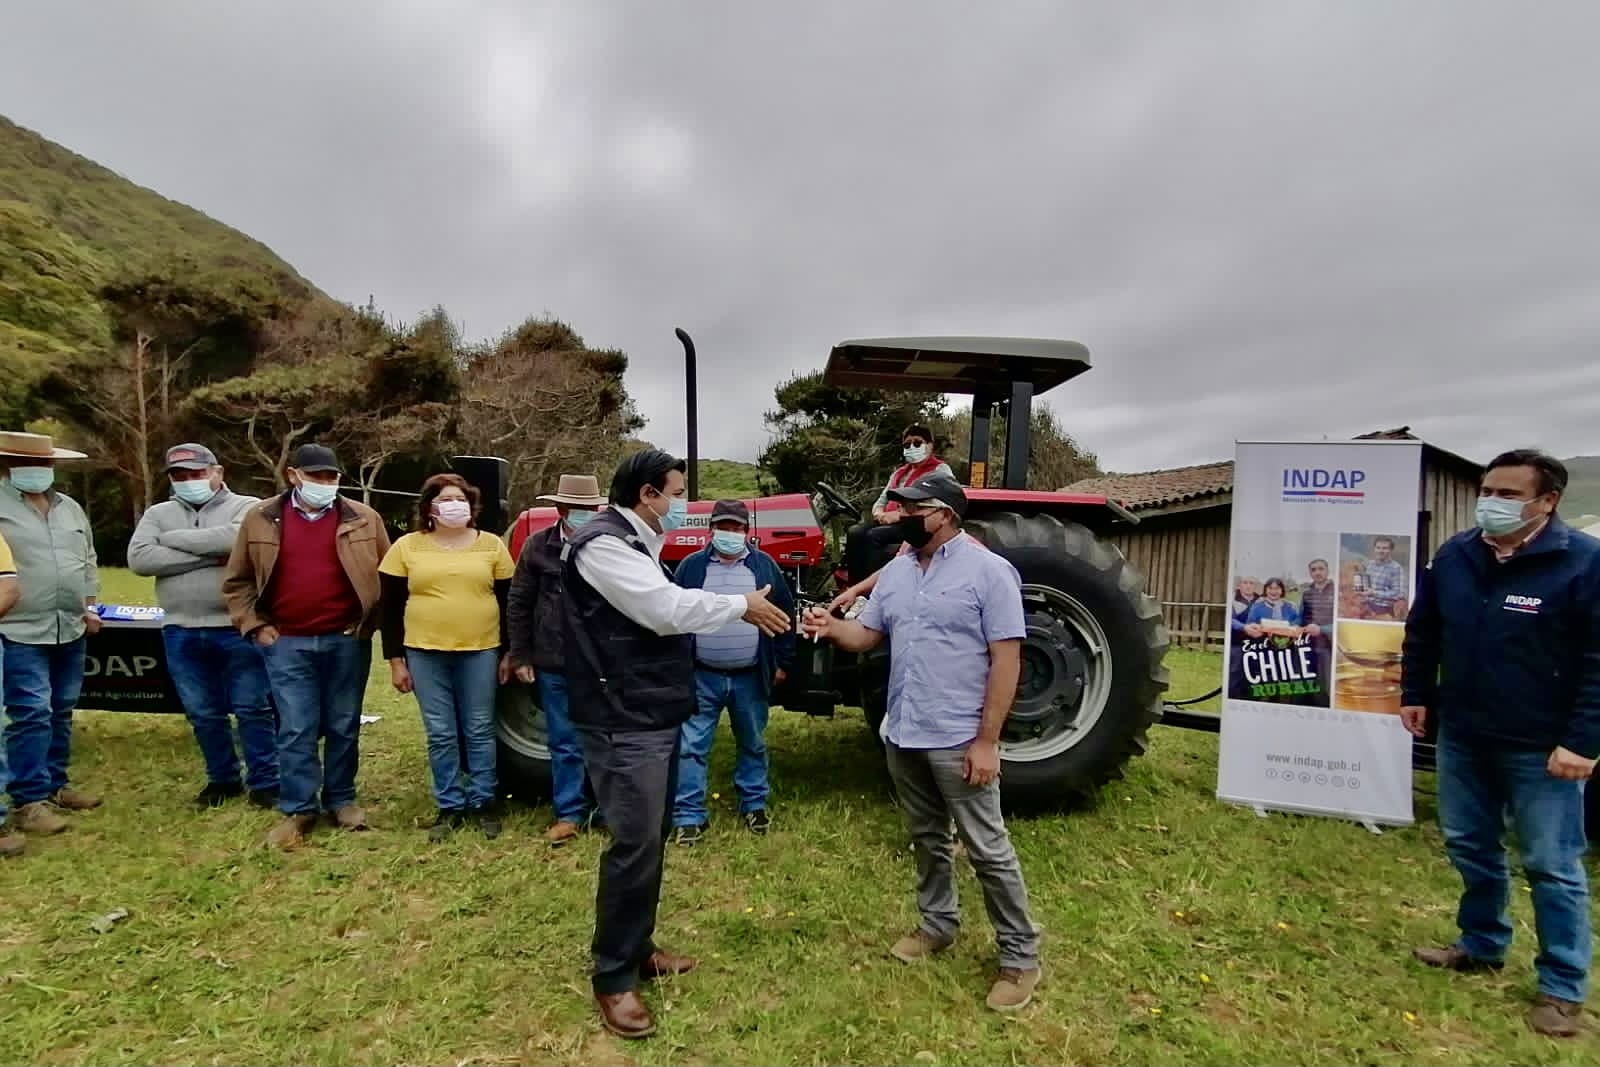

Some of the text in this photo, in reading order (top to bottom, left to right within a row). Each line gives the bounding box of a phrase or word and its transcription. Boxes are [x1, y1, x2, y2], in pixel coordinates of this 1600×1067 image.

[1283, 469, 1365, 488] INDAP
[680, 517, 711, 528] ERGU
[1505, 594, 1542, 606] INDAP
[84, 655, 157, 676] DAP
[1243, 647, 1317, 684] CHILE
[1266, 753, 1361, 772] www.indap.gob.cl
